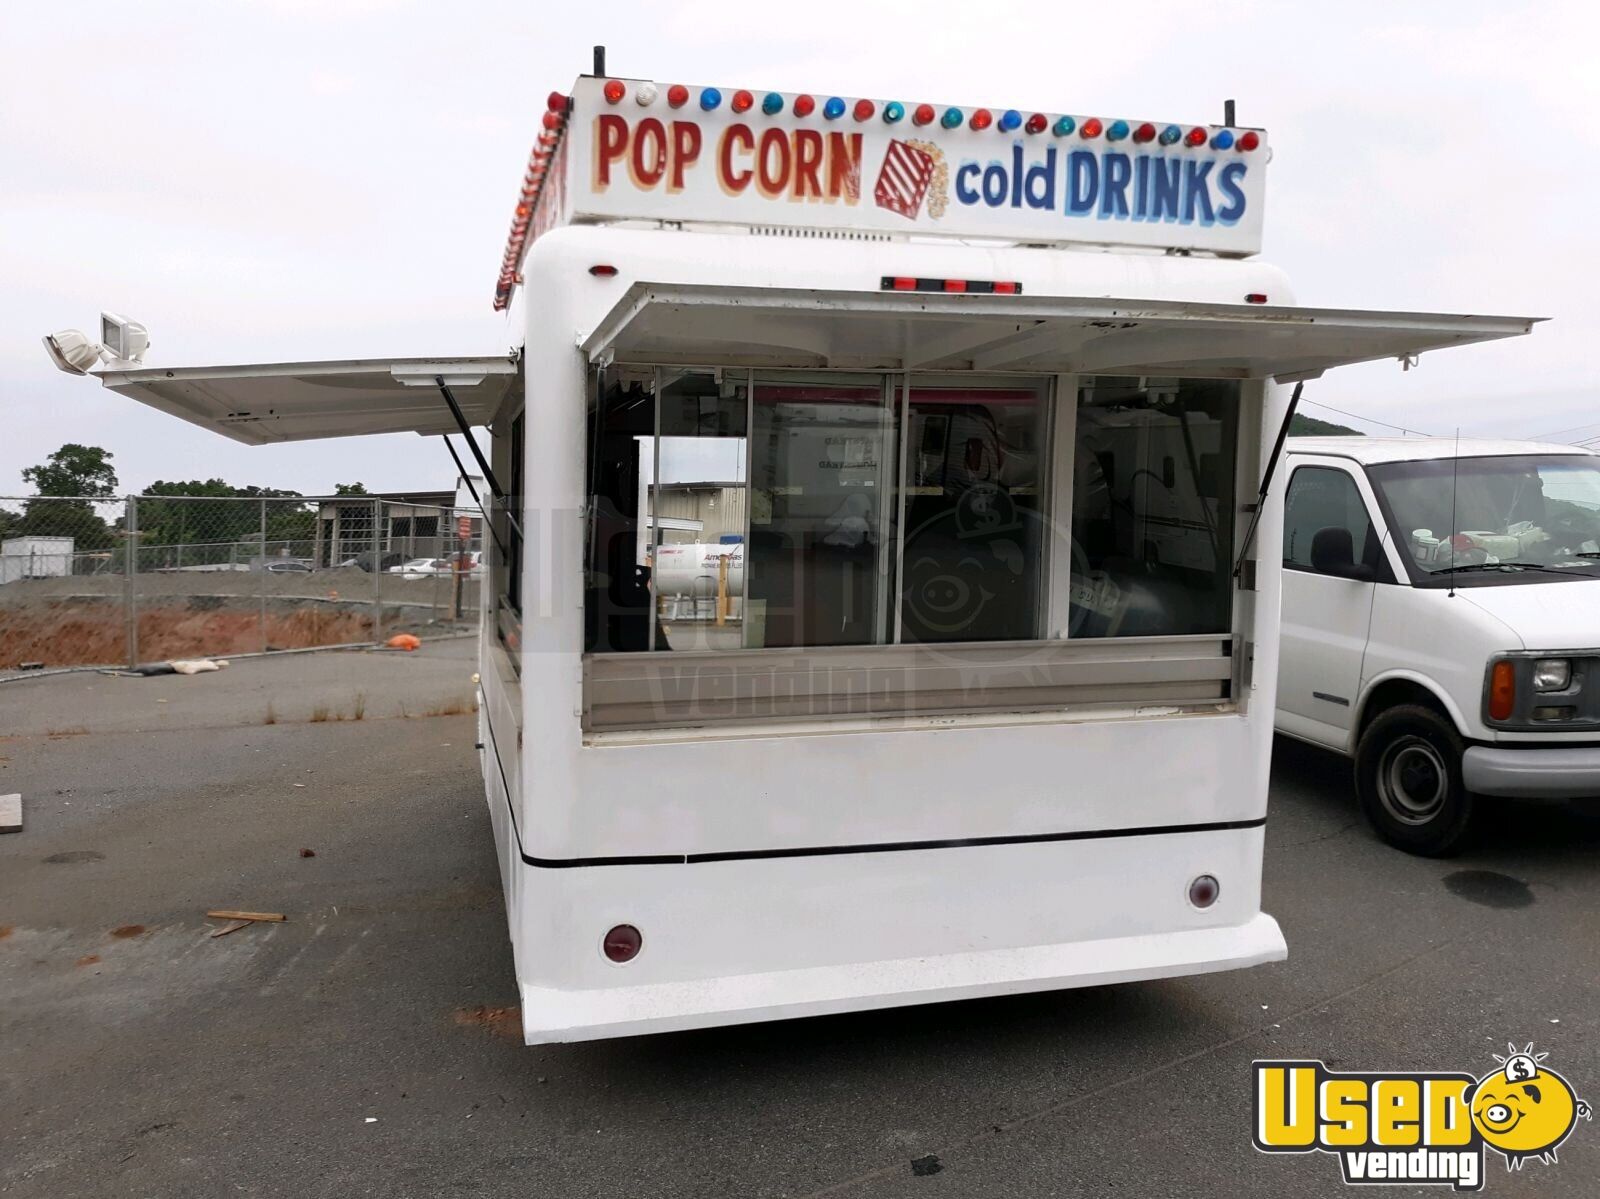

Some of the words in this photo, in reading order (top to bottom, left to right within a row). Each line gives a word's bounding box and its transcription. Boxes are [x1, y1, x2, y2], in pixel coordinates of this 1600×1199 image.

[595, 114, 702, 193] POP
[716, 121, 864, 203] CORN
[955, 144, 1057, 212] cold
[1064, 149, 1248, 227] DRINKS
